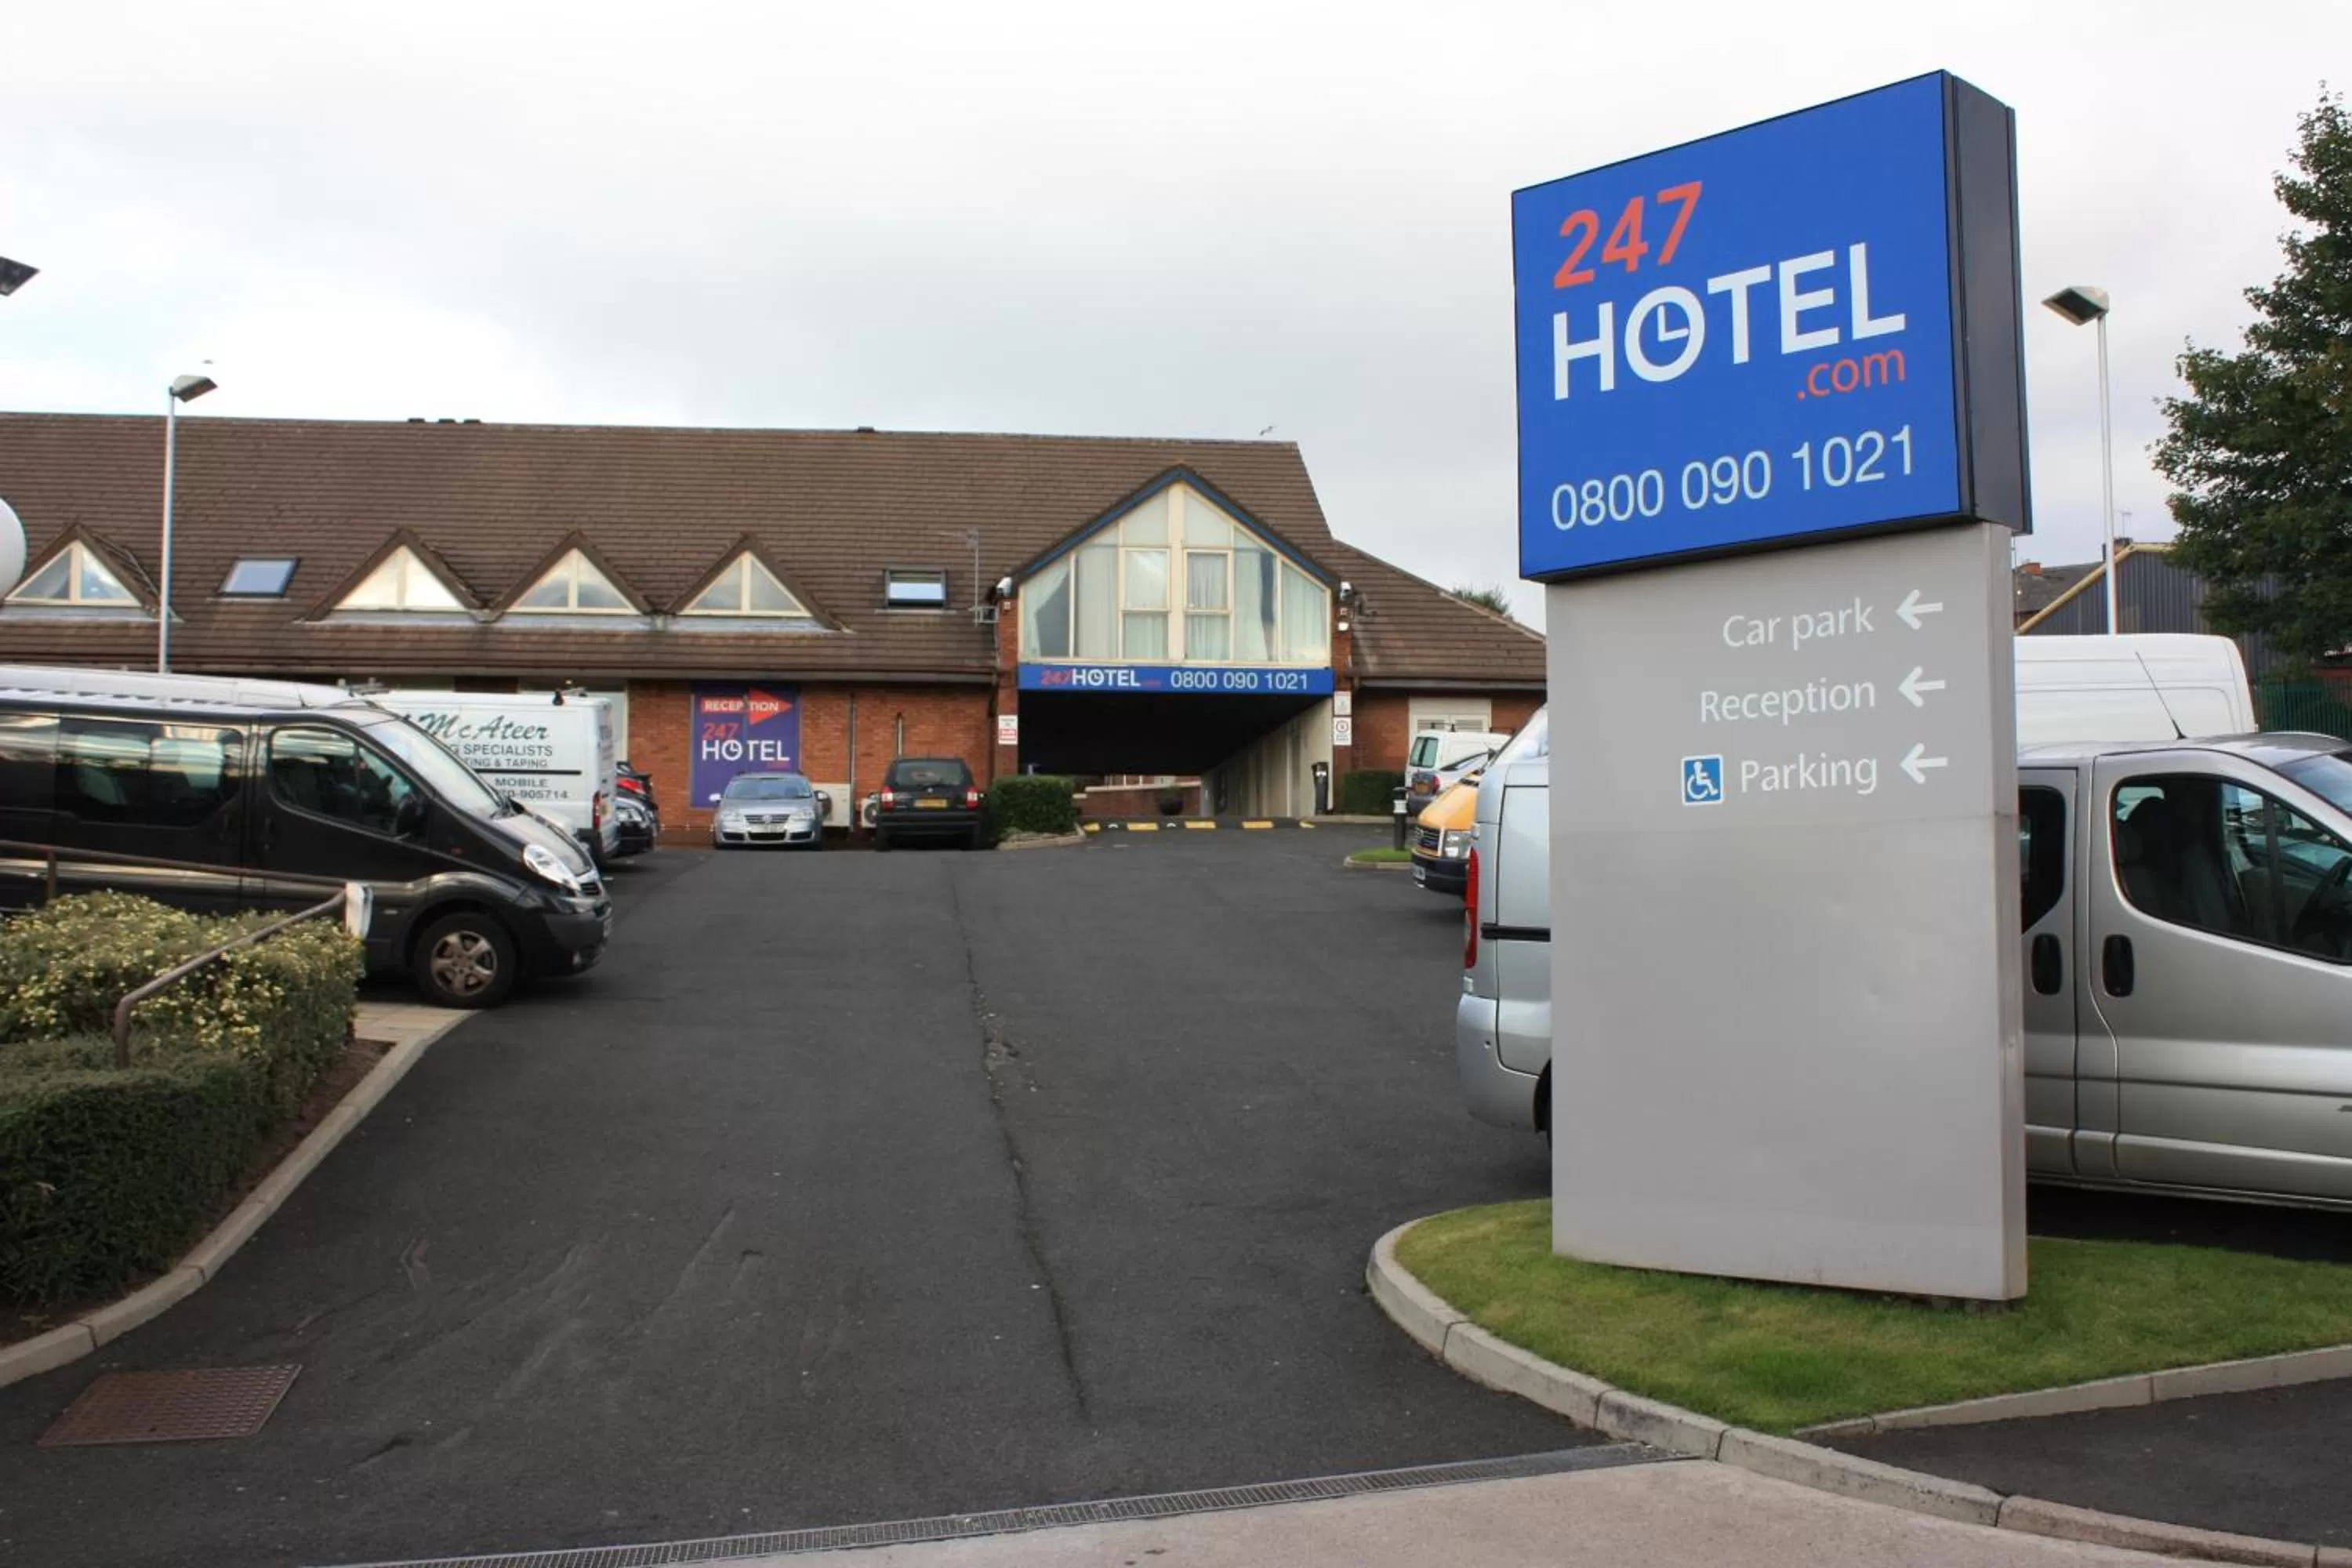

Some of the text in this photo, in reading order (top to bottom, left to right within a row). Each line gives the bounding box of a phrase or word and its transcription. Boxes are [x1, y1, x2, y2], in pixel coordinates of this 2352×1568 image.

[1553, 181, 1702, 289] 247
[1553, 241, 1906, 401] HOTEL
[1796, 349, 1906, 400] .com
[1552, 424, 1913, 530] 0800 090 1021
[1722, 597, 1875, 651] Car park
[1072, 668, 1141, 687] HOTEL
[1171, 670, 1217, 688] 0800
[1223, 671, 1258, 689] 090
[1265, 672, 1308, 690] 1021
[1700, 677, 1876, 725] Reception
[463, 745, 553, 757] SPECIALISTS
[702, 722, 739, 740] 247
[702, 739, 791, 761] HOTEL
[495, 778, 549, 788] MOBILE
[506, 758, 547, 768] TAPING
[1740, 753, 1878, 794] Parking
